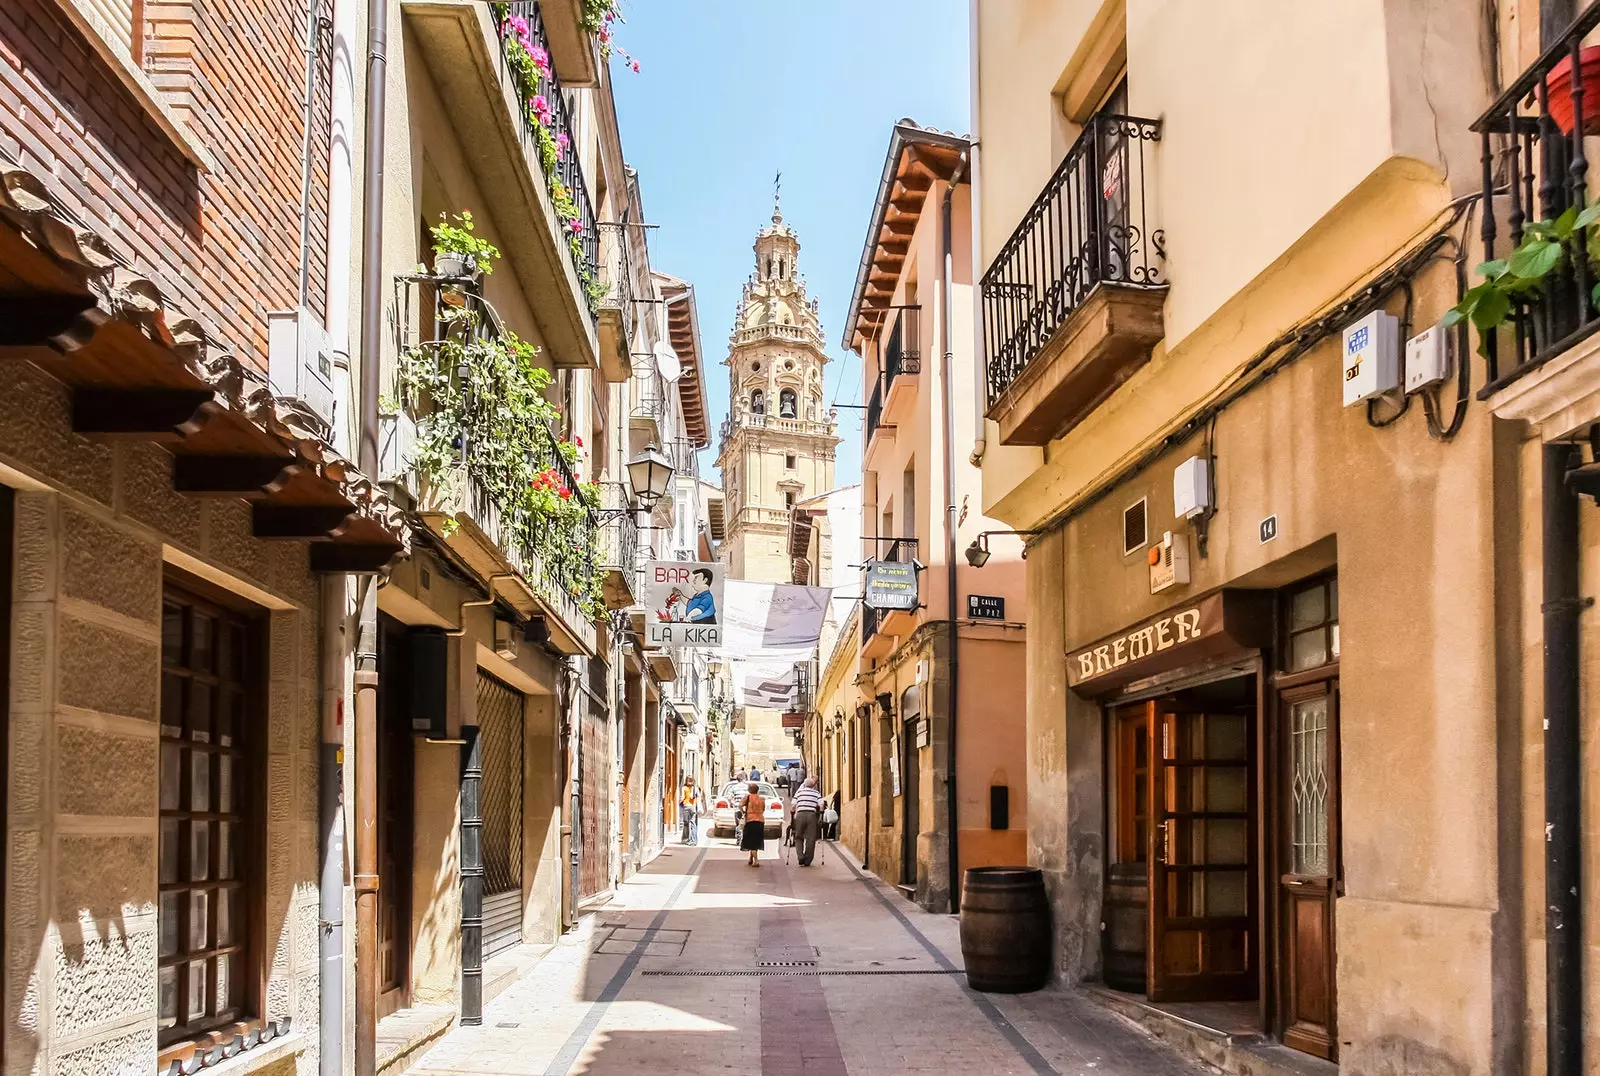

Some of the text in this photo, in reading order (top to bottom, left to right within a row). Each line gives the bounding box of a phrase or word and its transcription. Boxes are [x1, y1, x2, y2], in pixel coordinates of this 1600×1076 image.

[1263, 521, 1273, 537] 14
[655, 567, 690, 583] BAR
[871, 592, 913, 604] CHAMONIX
[652, 627, 717, 643] LA KIKA
[1078, 608, 1201, 679] BREMEN
